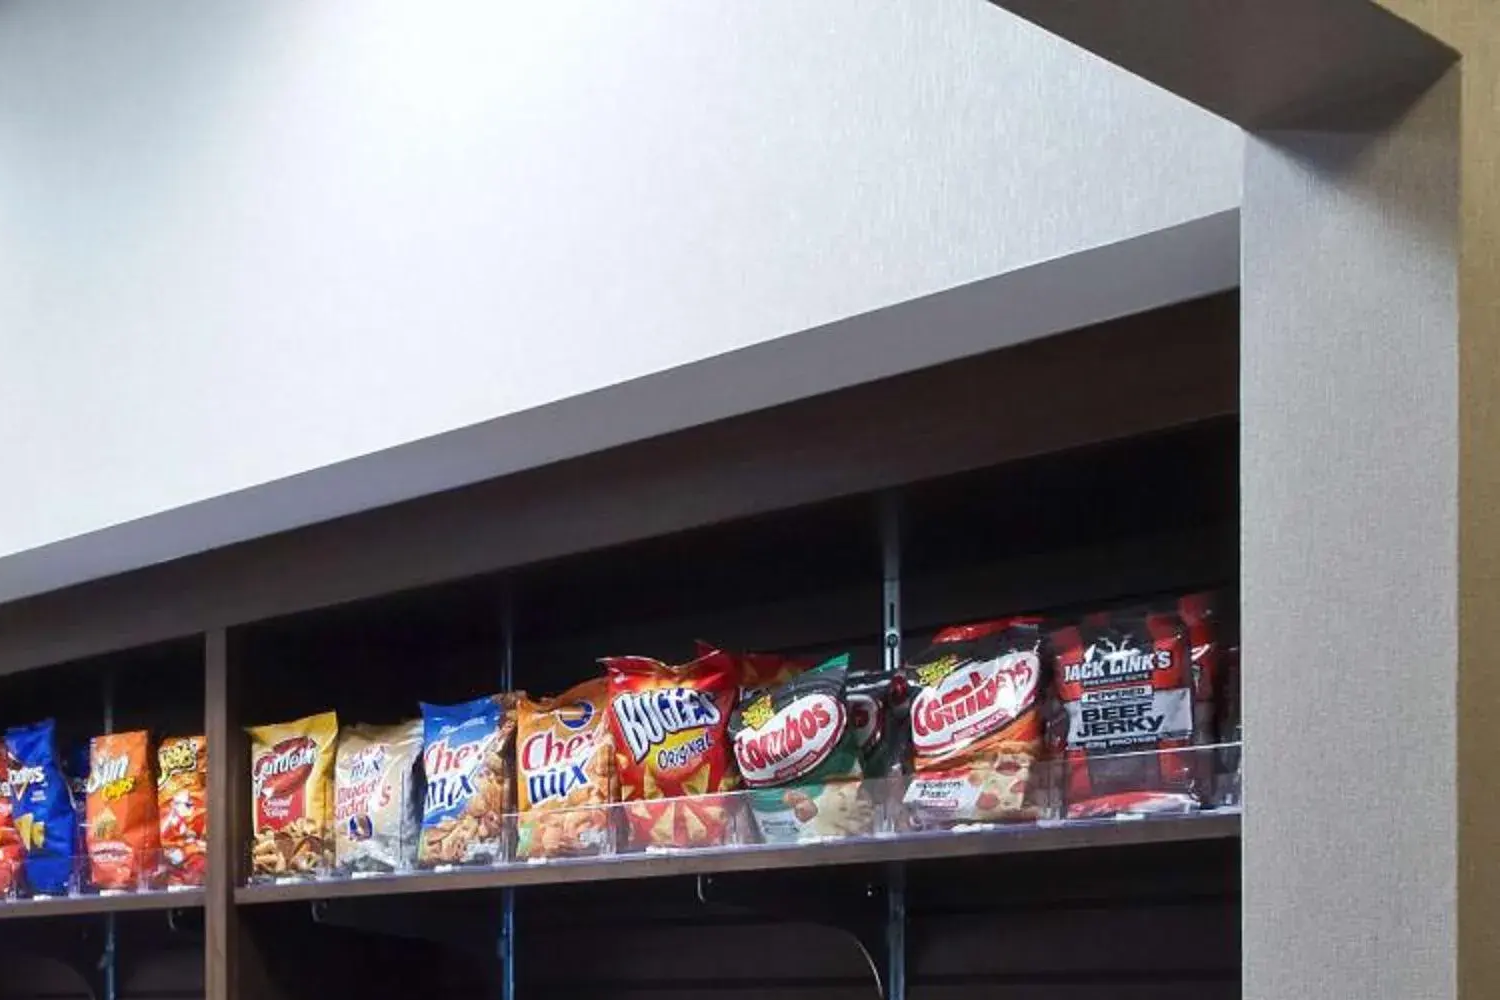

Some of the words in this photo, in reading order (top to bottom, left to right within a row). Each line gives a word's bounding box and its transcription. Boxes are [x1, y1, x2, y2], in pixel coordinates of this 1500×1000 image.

[1063, 659, 1106, 682] JACK
[1081, 701, 1153, 723] BEEF
[612, 686, 721, 764] BUGLES
[735, 701, 832, 773] Combos
[1076, 714, 1166, 738] JERKY
